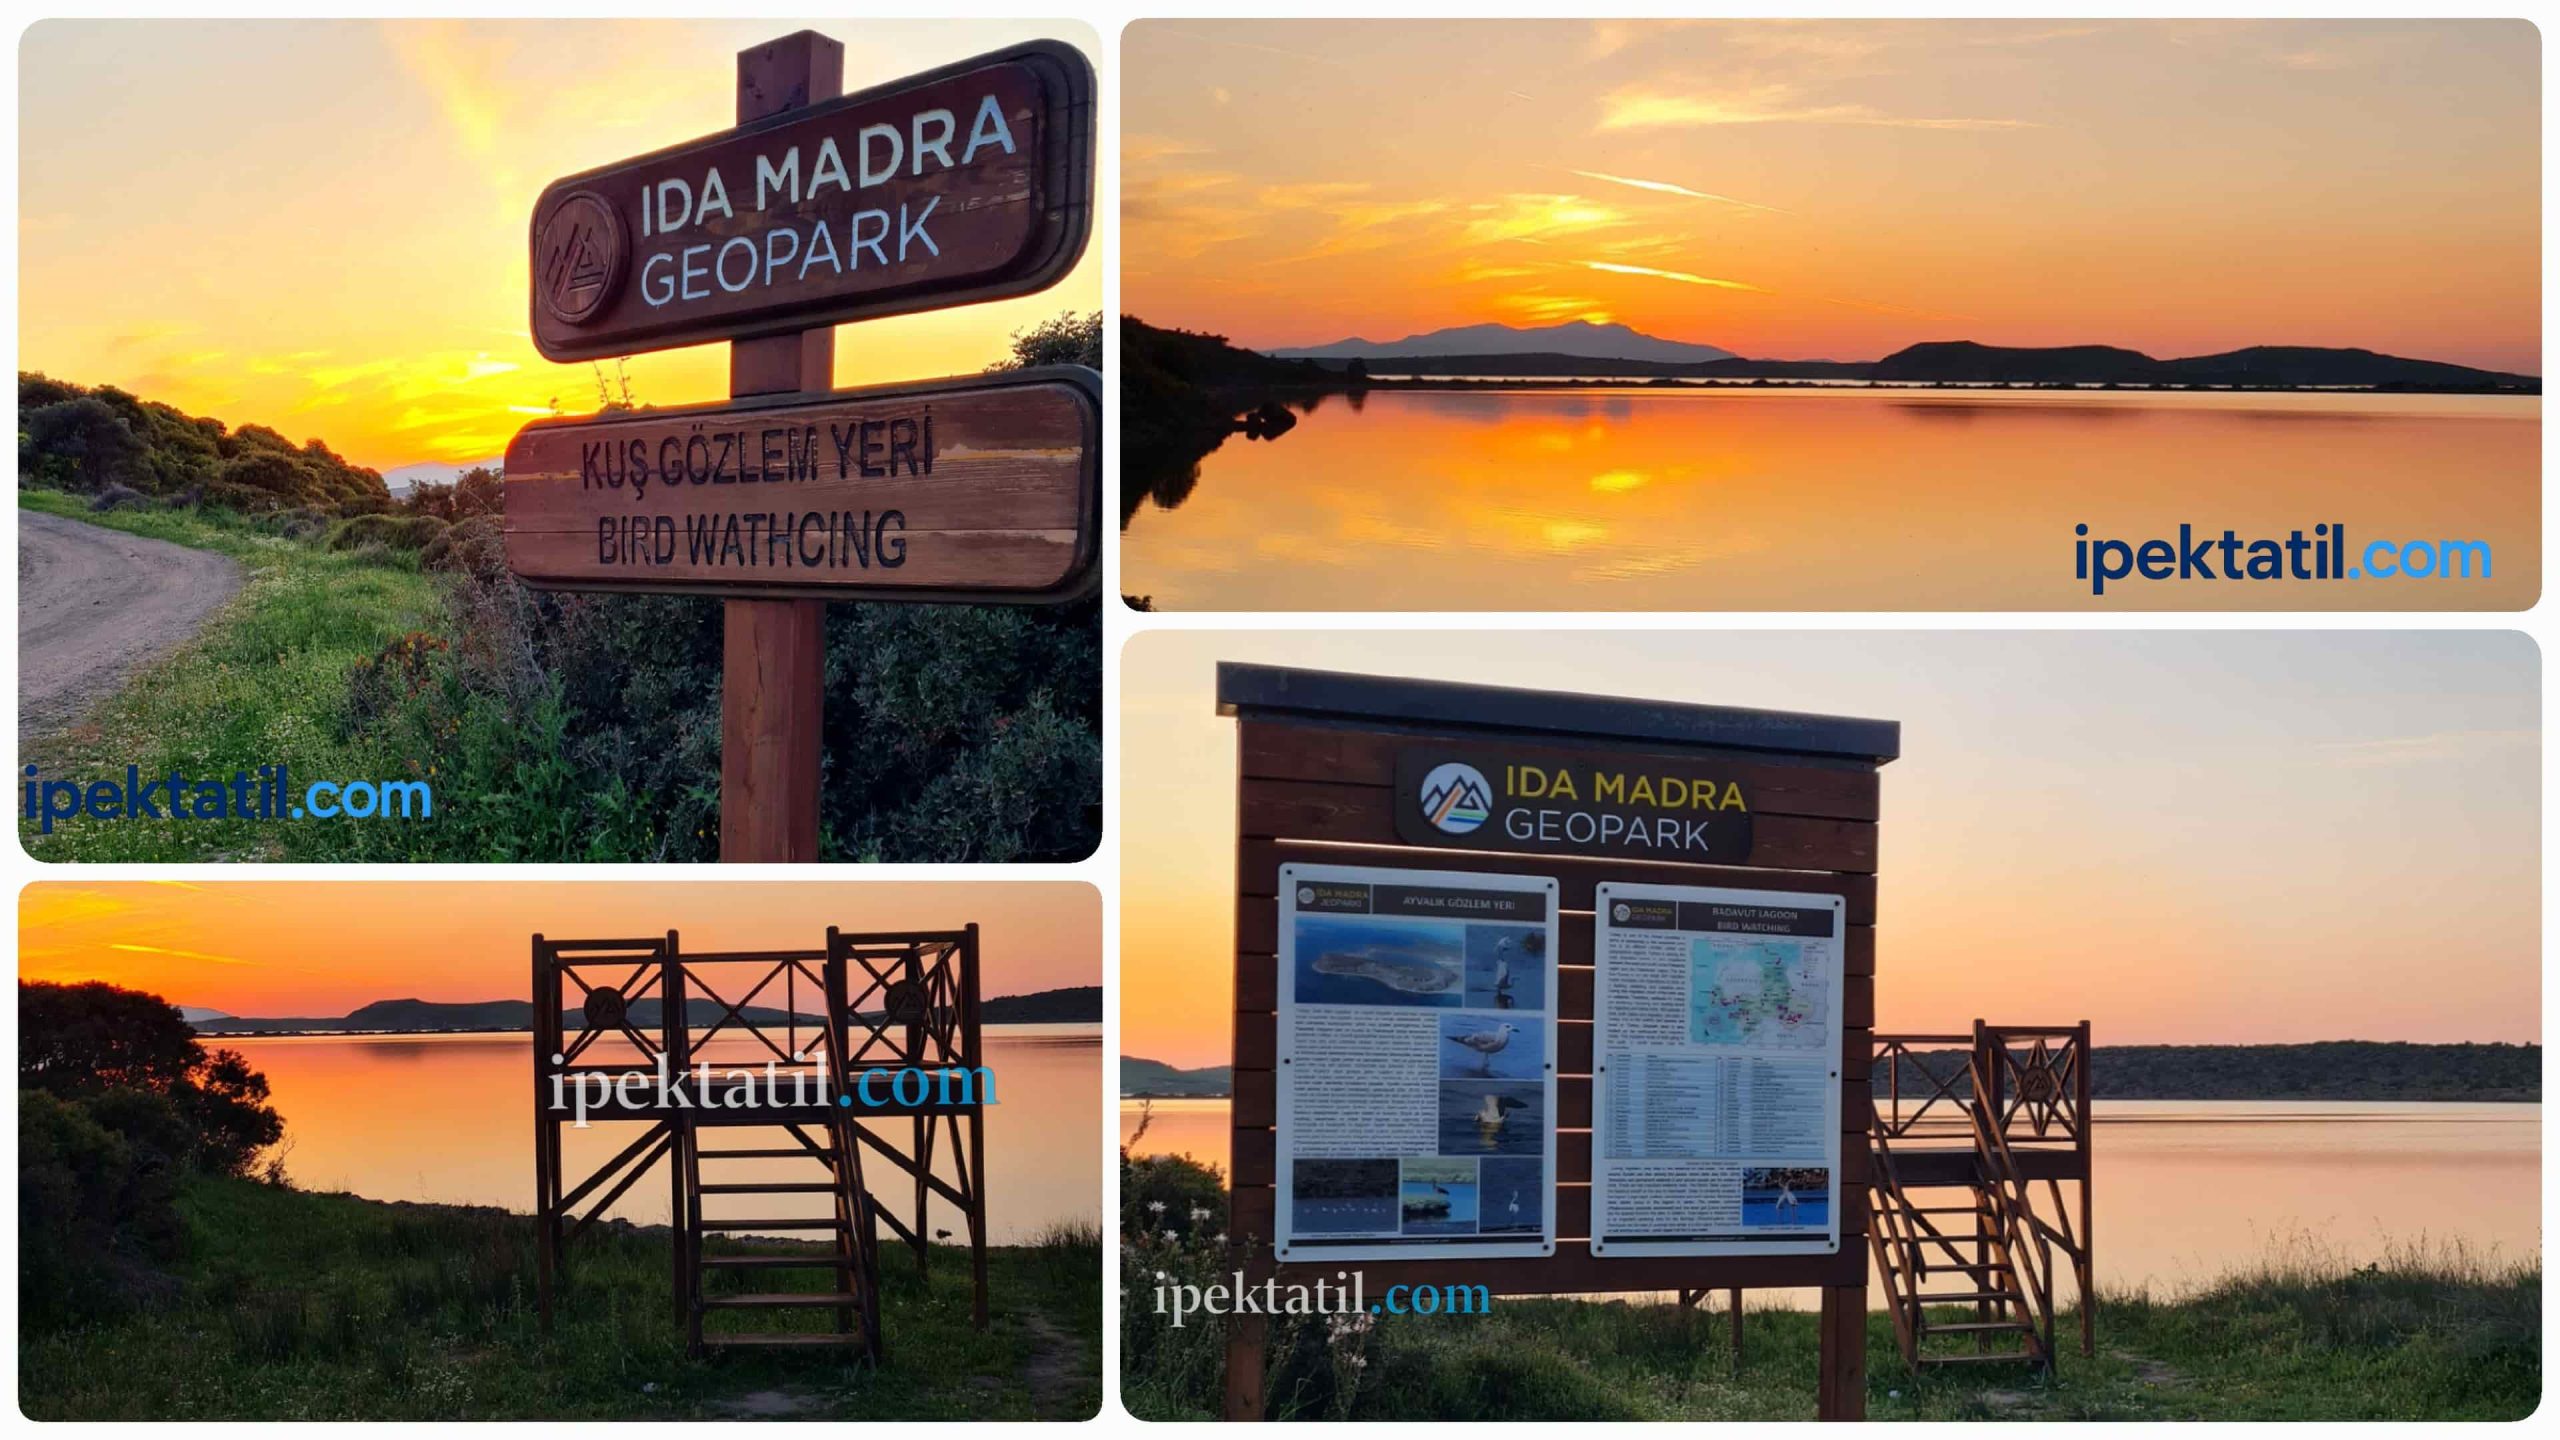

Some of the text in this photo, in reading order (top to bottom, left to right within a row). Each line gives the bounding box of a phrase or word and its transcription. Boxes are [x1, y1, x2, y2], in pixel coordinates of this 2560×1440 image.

[641, 94, 1016, 236] IDA MADRA
[641, 196, 942, 308] GEOPARK
[582, 405, 934, 500] KUŞ GÖZLEM YERİ
[598, 508, 907, 568] BIRD WATHCING
[1506, 765, 1748, 812] IDA MADRA
[1504, 808, 1709, 851] GEOPARK
[1403, 896, 1446, 907] AYVALIK
[1447, 898, 1491, 910] GÖZLEM
[1712, 907, 1798, 920] BADAVUT LAGOON
[1717, 921, 1791, 932] BIRD WATCHING
